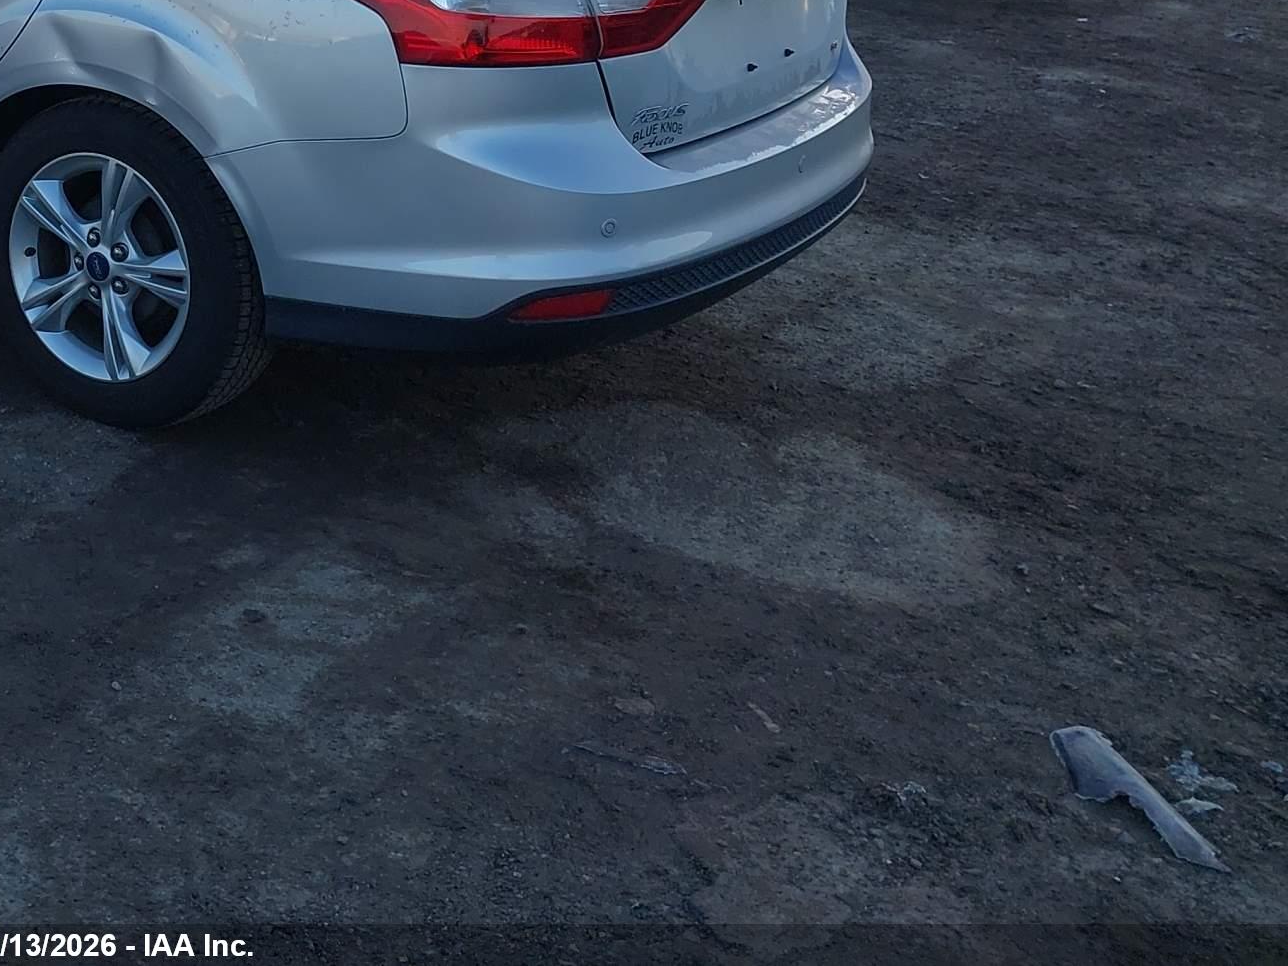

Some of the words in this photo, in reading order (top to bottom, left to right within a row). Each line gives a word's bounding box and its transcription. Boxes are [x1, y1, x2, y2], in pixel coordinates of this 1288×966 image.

[632, 124, 659, 144] BLUE
[661, 121, 684, 135] KNOB
[641, 137, 675, 150] Auto
